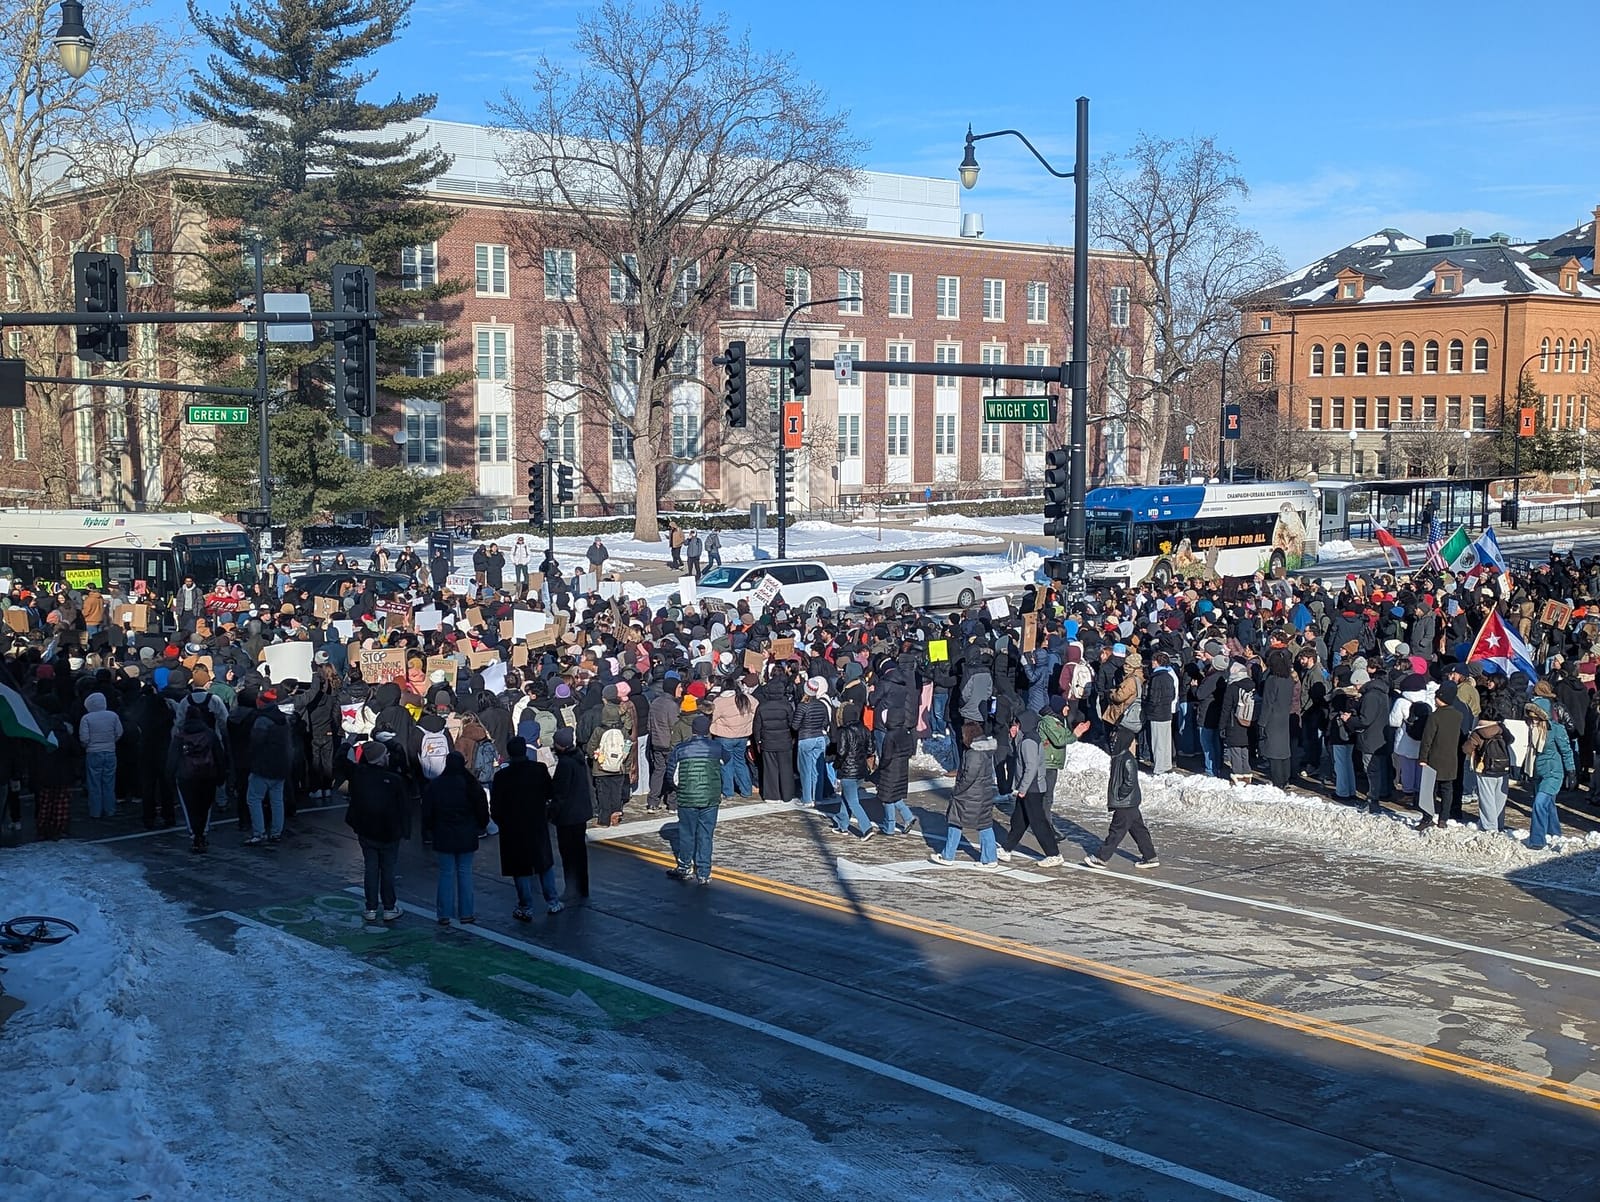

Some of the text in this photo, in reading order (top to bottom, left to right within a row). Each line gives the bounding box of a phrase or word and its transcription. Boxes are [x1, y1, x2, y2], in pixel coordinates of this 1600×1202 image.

[194, 410, 245, 421] GREEN ST
[988, 403, 1045, 418] WRIGHT ST
[788, 416, 798, 435] I
[1228, 414, 1238, 430] I
[83, 517, 110, 528] Hybrid
[1198, 533, 1266, 548] CLEANER AIR FOR ALL
[361, 651, 387, 664] STOP
